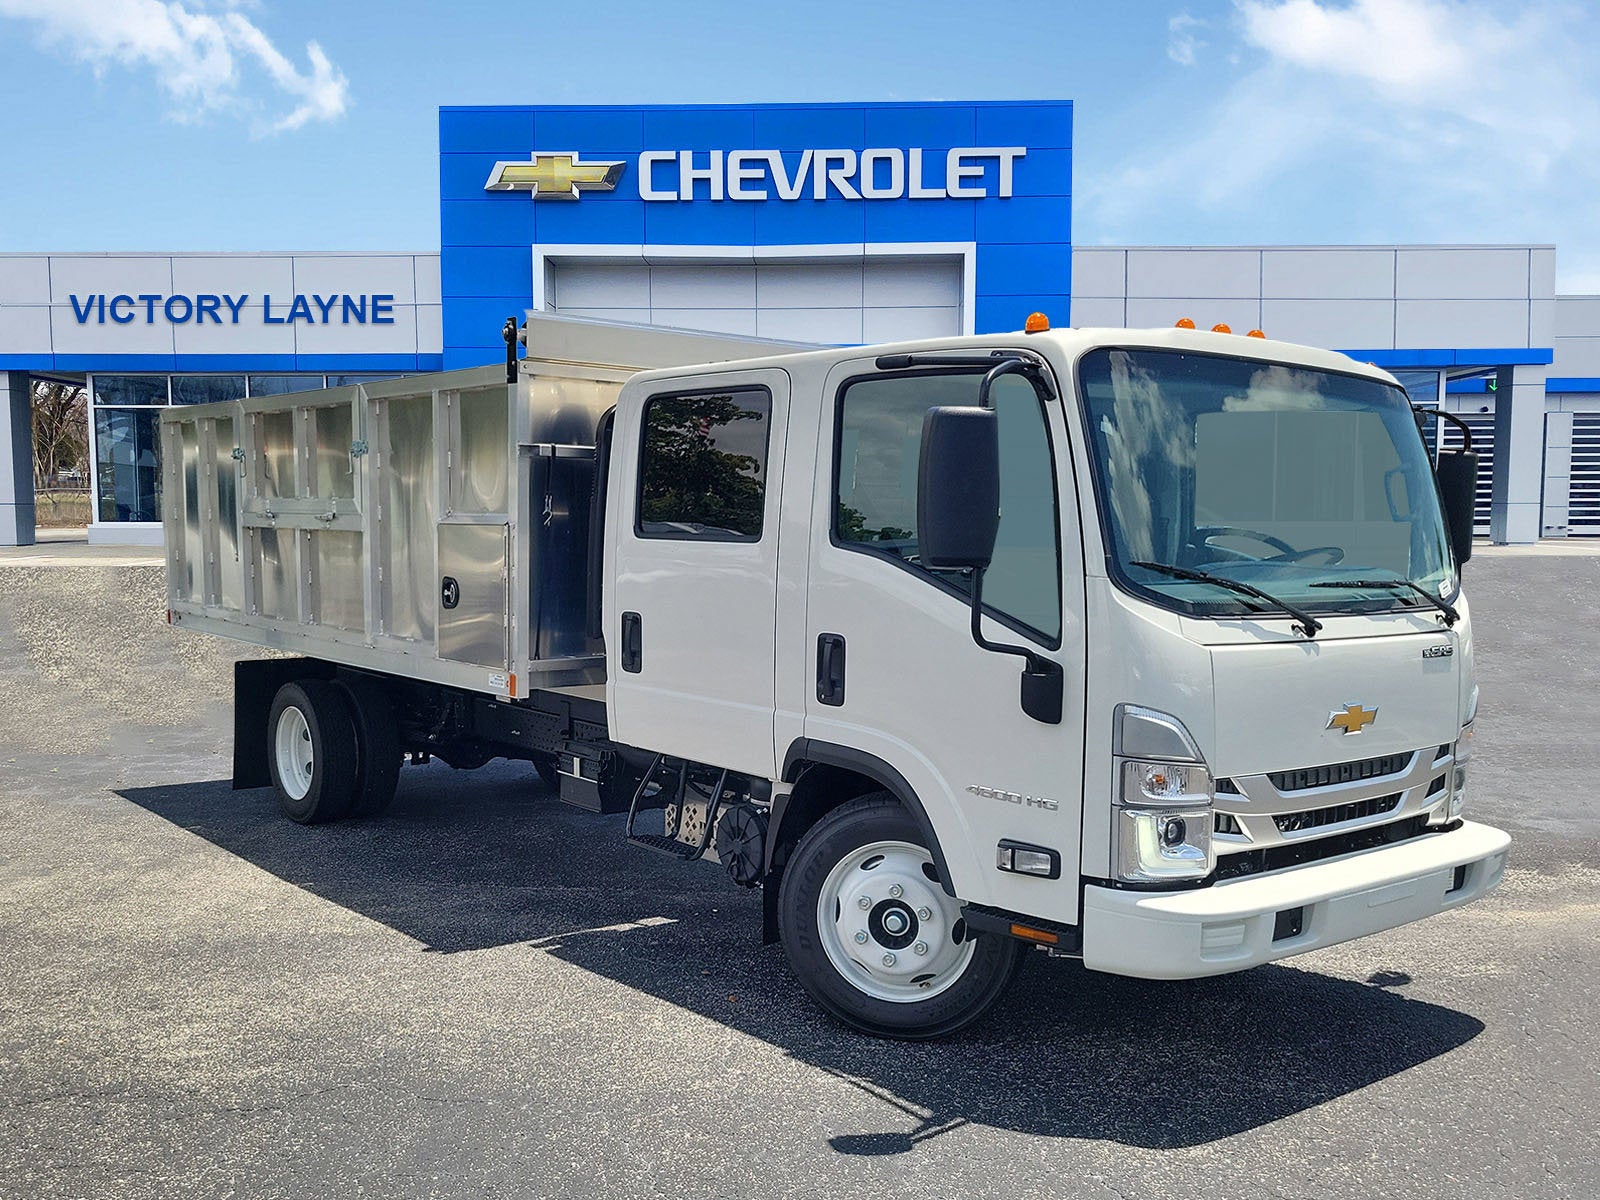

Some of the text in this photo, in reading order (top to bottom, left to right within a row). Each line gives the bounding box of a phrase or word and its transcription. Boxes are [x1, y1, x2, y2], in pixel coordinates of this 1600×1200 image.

[638, 146, 1027, 201] CHEVROLET
[69, 294, 394, 324] VICTORY LAYNE
[1026, 795, 1059, 811] HG
